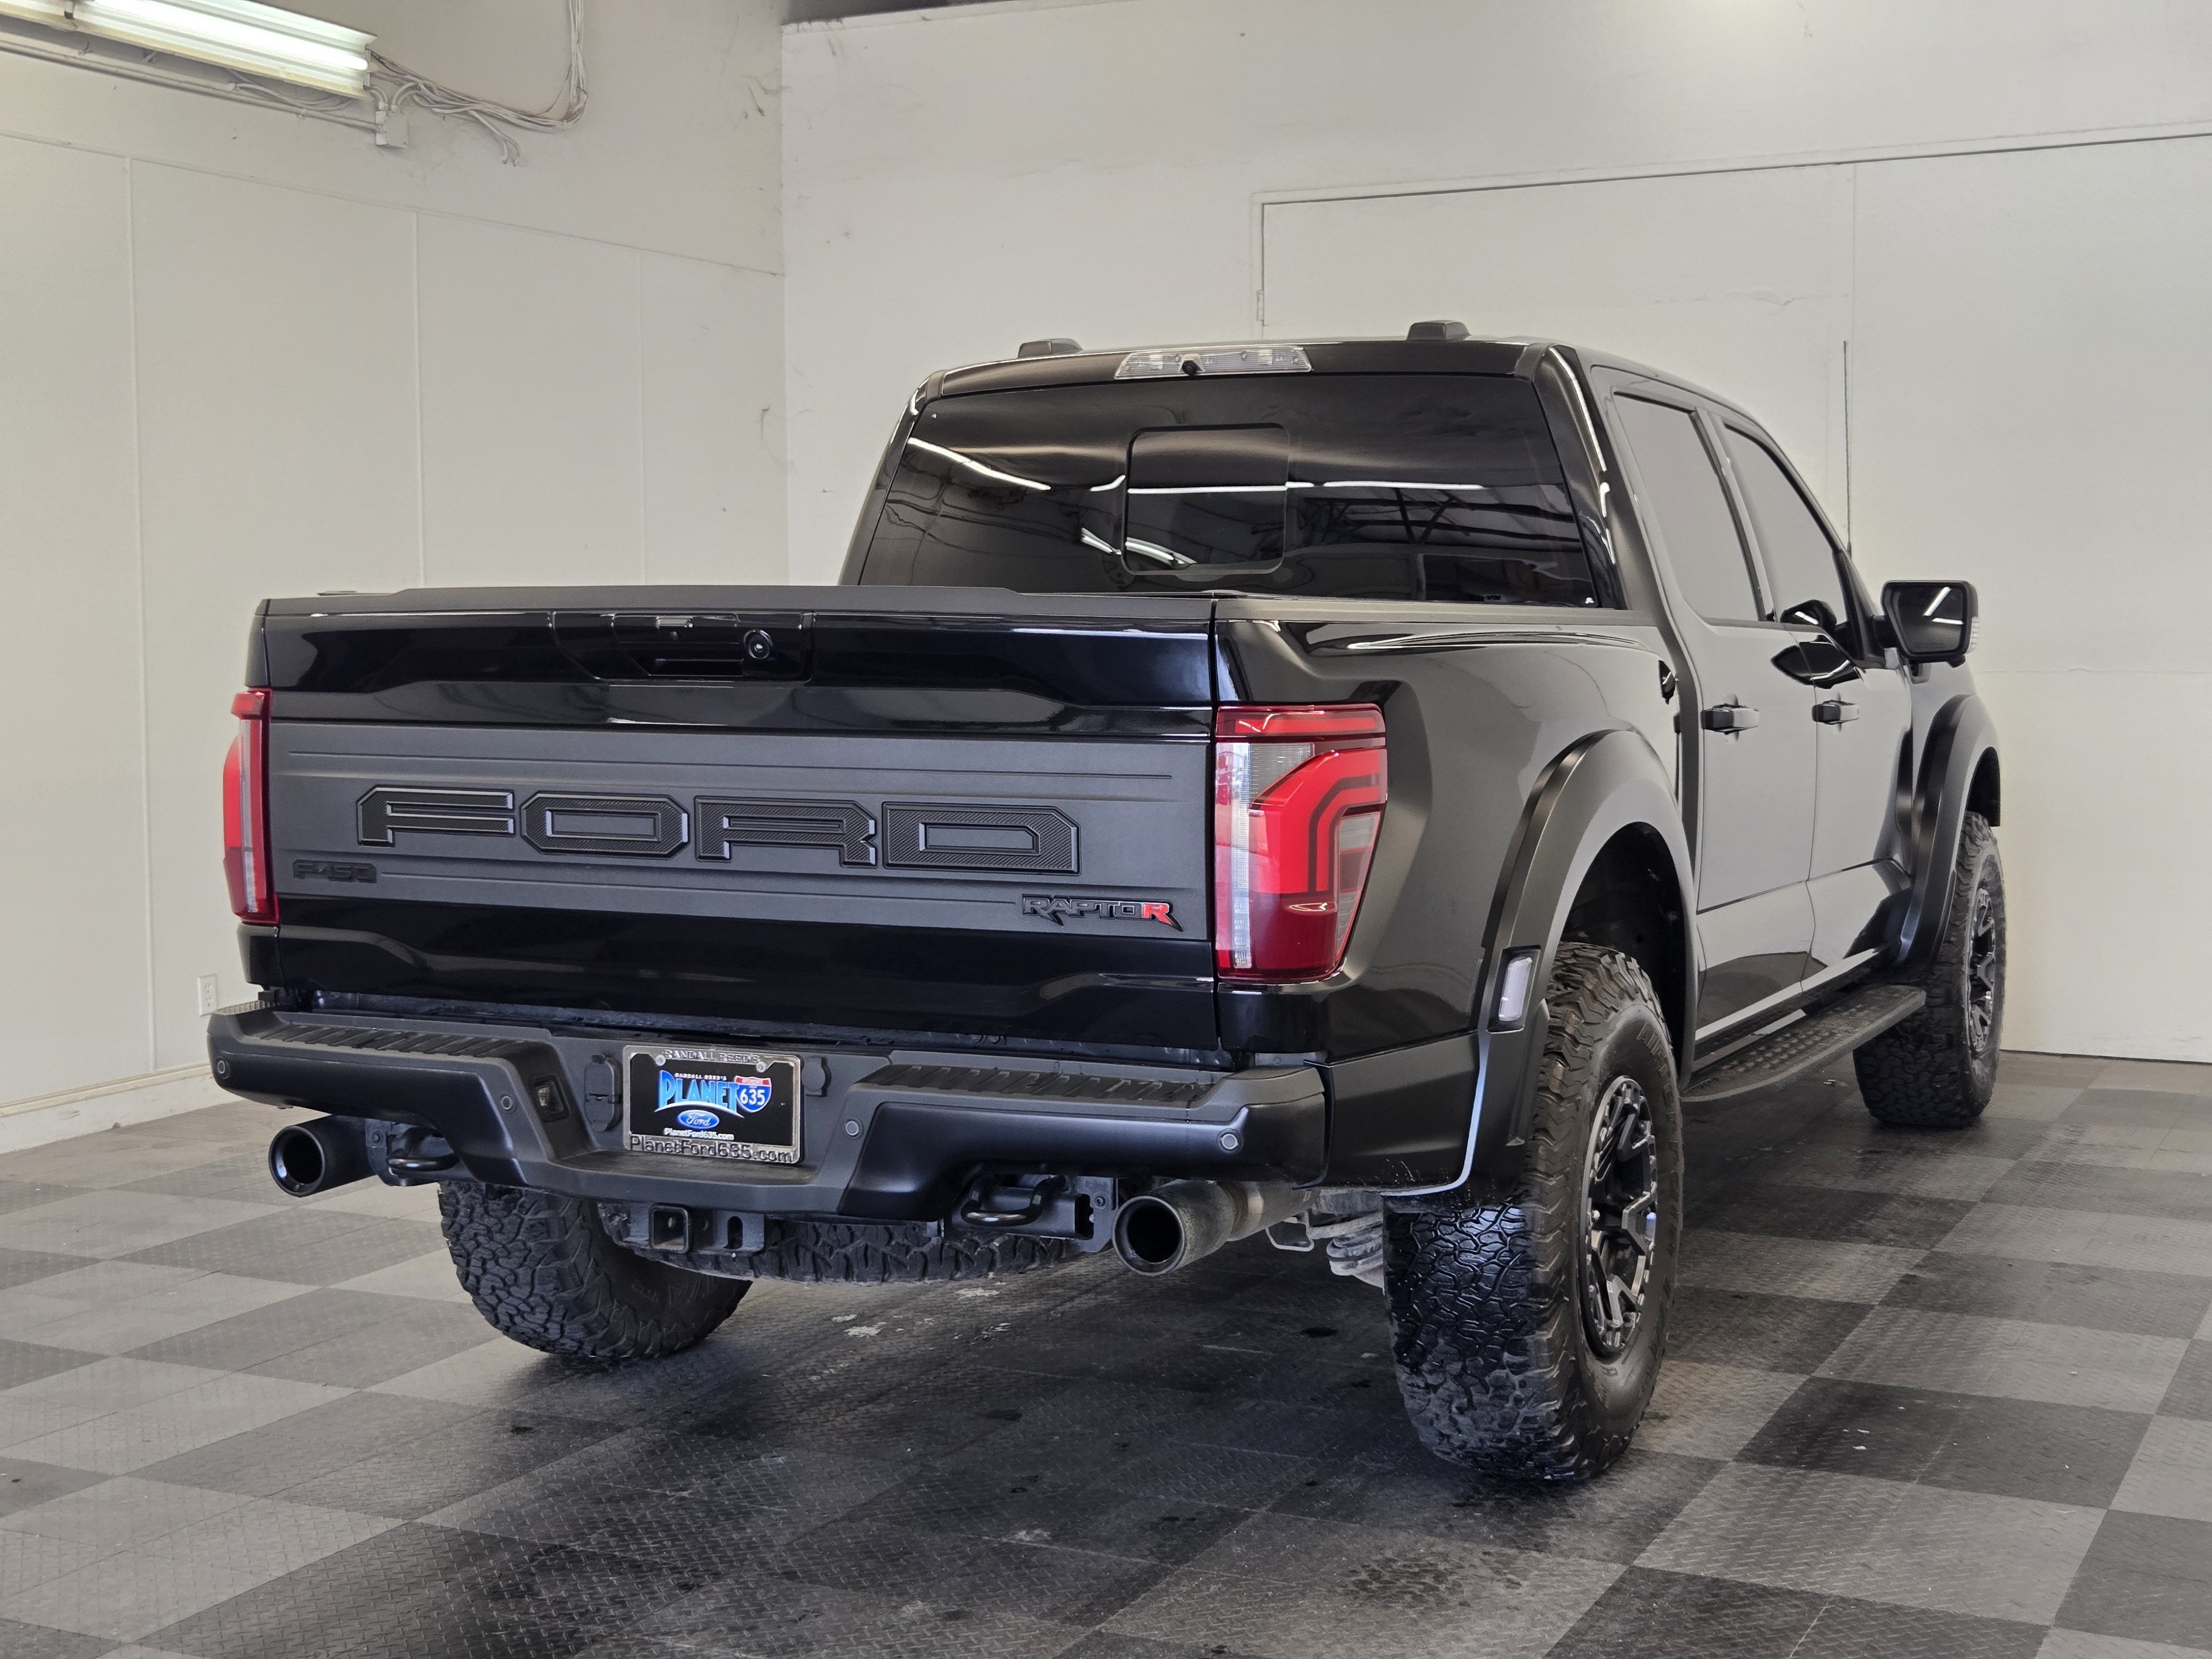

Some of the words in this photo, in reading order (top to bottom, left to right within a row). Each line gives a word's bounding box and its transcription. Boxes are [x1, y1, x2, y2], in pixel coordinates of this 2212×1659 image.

[357, 785, 1082, 877] FORD
[293, 860, 377, 883] F-150
[1022, 894, 1184, 932] RAPTOR
[665, 1049, 717, 1061] RANDALL
[719, 1052, 761, 1063] REED'S
[659, 1070, 740, 1114] PLANET
[740, 1088, 766, 1105] 635
[686, 1113, 711, 1126] Ford
[664, 1128, 734, 1140] PlanetFord635.com
[630, 1135, 793, 1162] PlanetFord635.com
